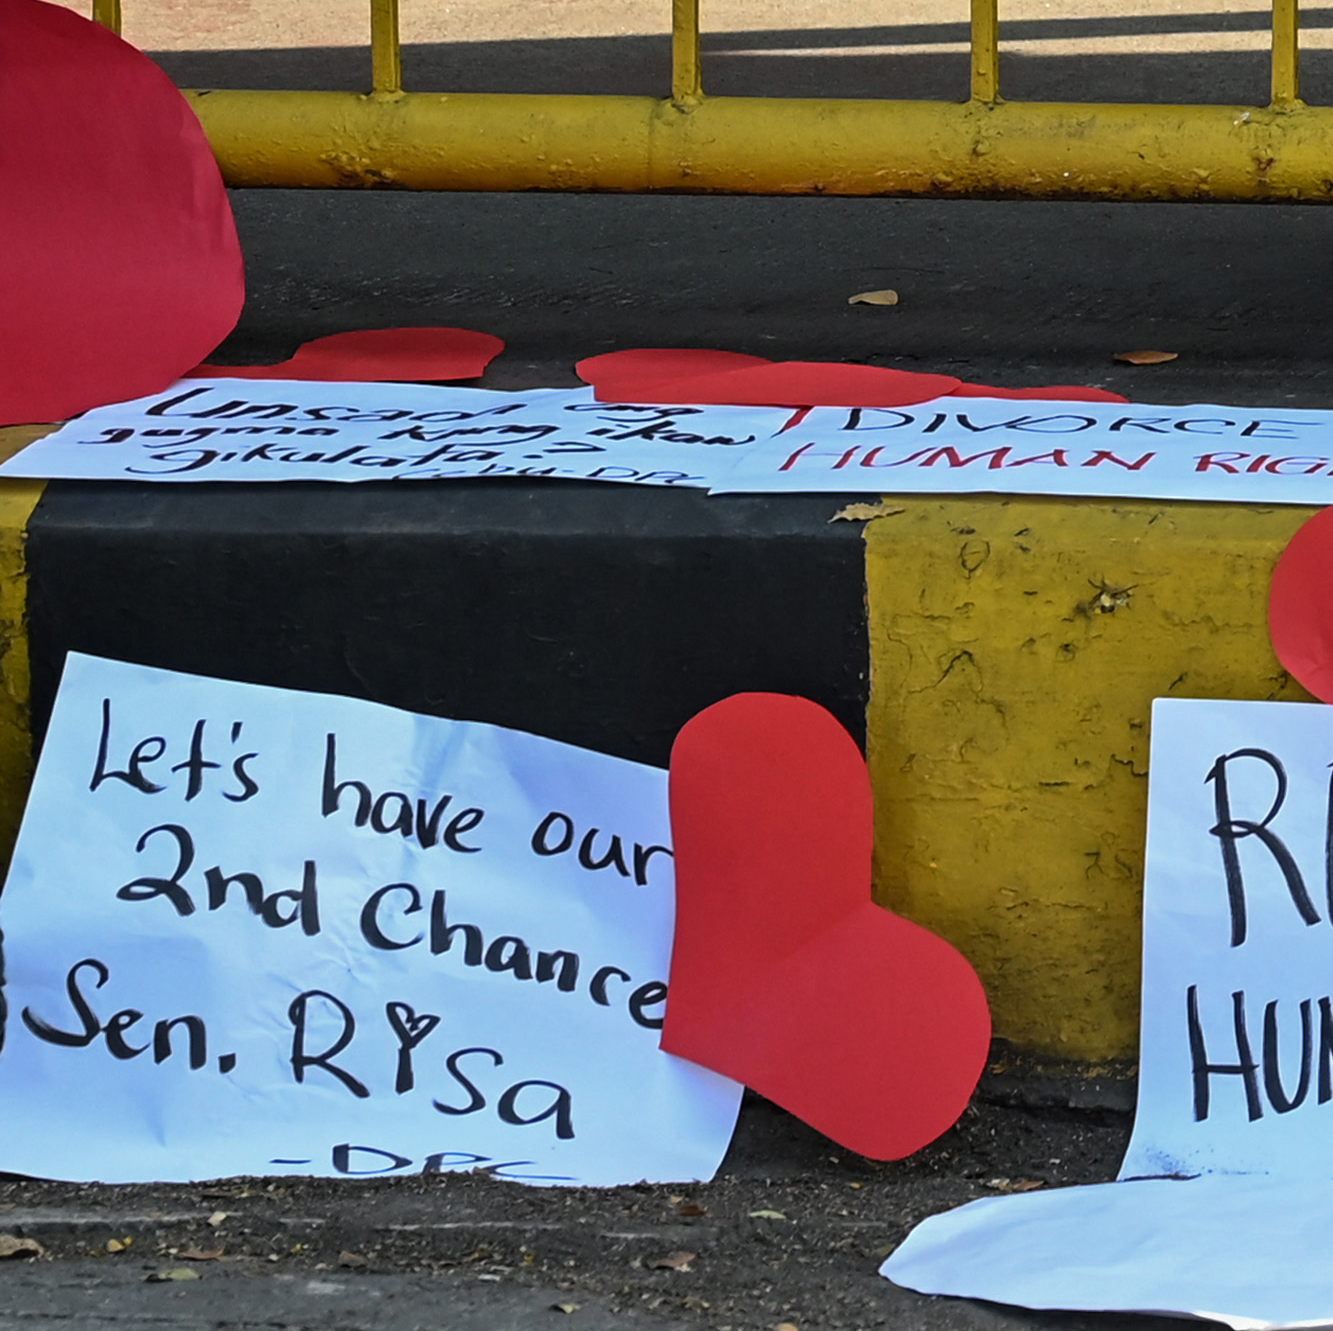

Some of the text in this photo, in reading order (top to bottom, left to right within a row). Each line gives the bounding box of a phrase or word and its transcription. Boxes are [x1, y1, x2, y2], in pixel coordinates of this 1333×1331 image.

[777, 442, 1157, 472] HUMAN
[842, 407, 1324, 441] DIVORCE
[89, 698, 676, 888] Let's have our
[116, 824, 668, 1030] 2nd Chance
[21, 958, 237, 1075] Sen.
